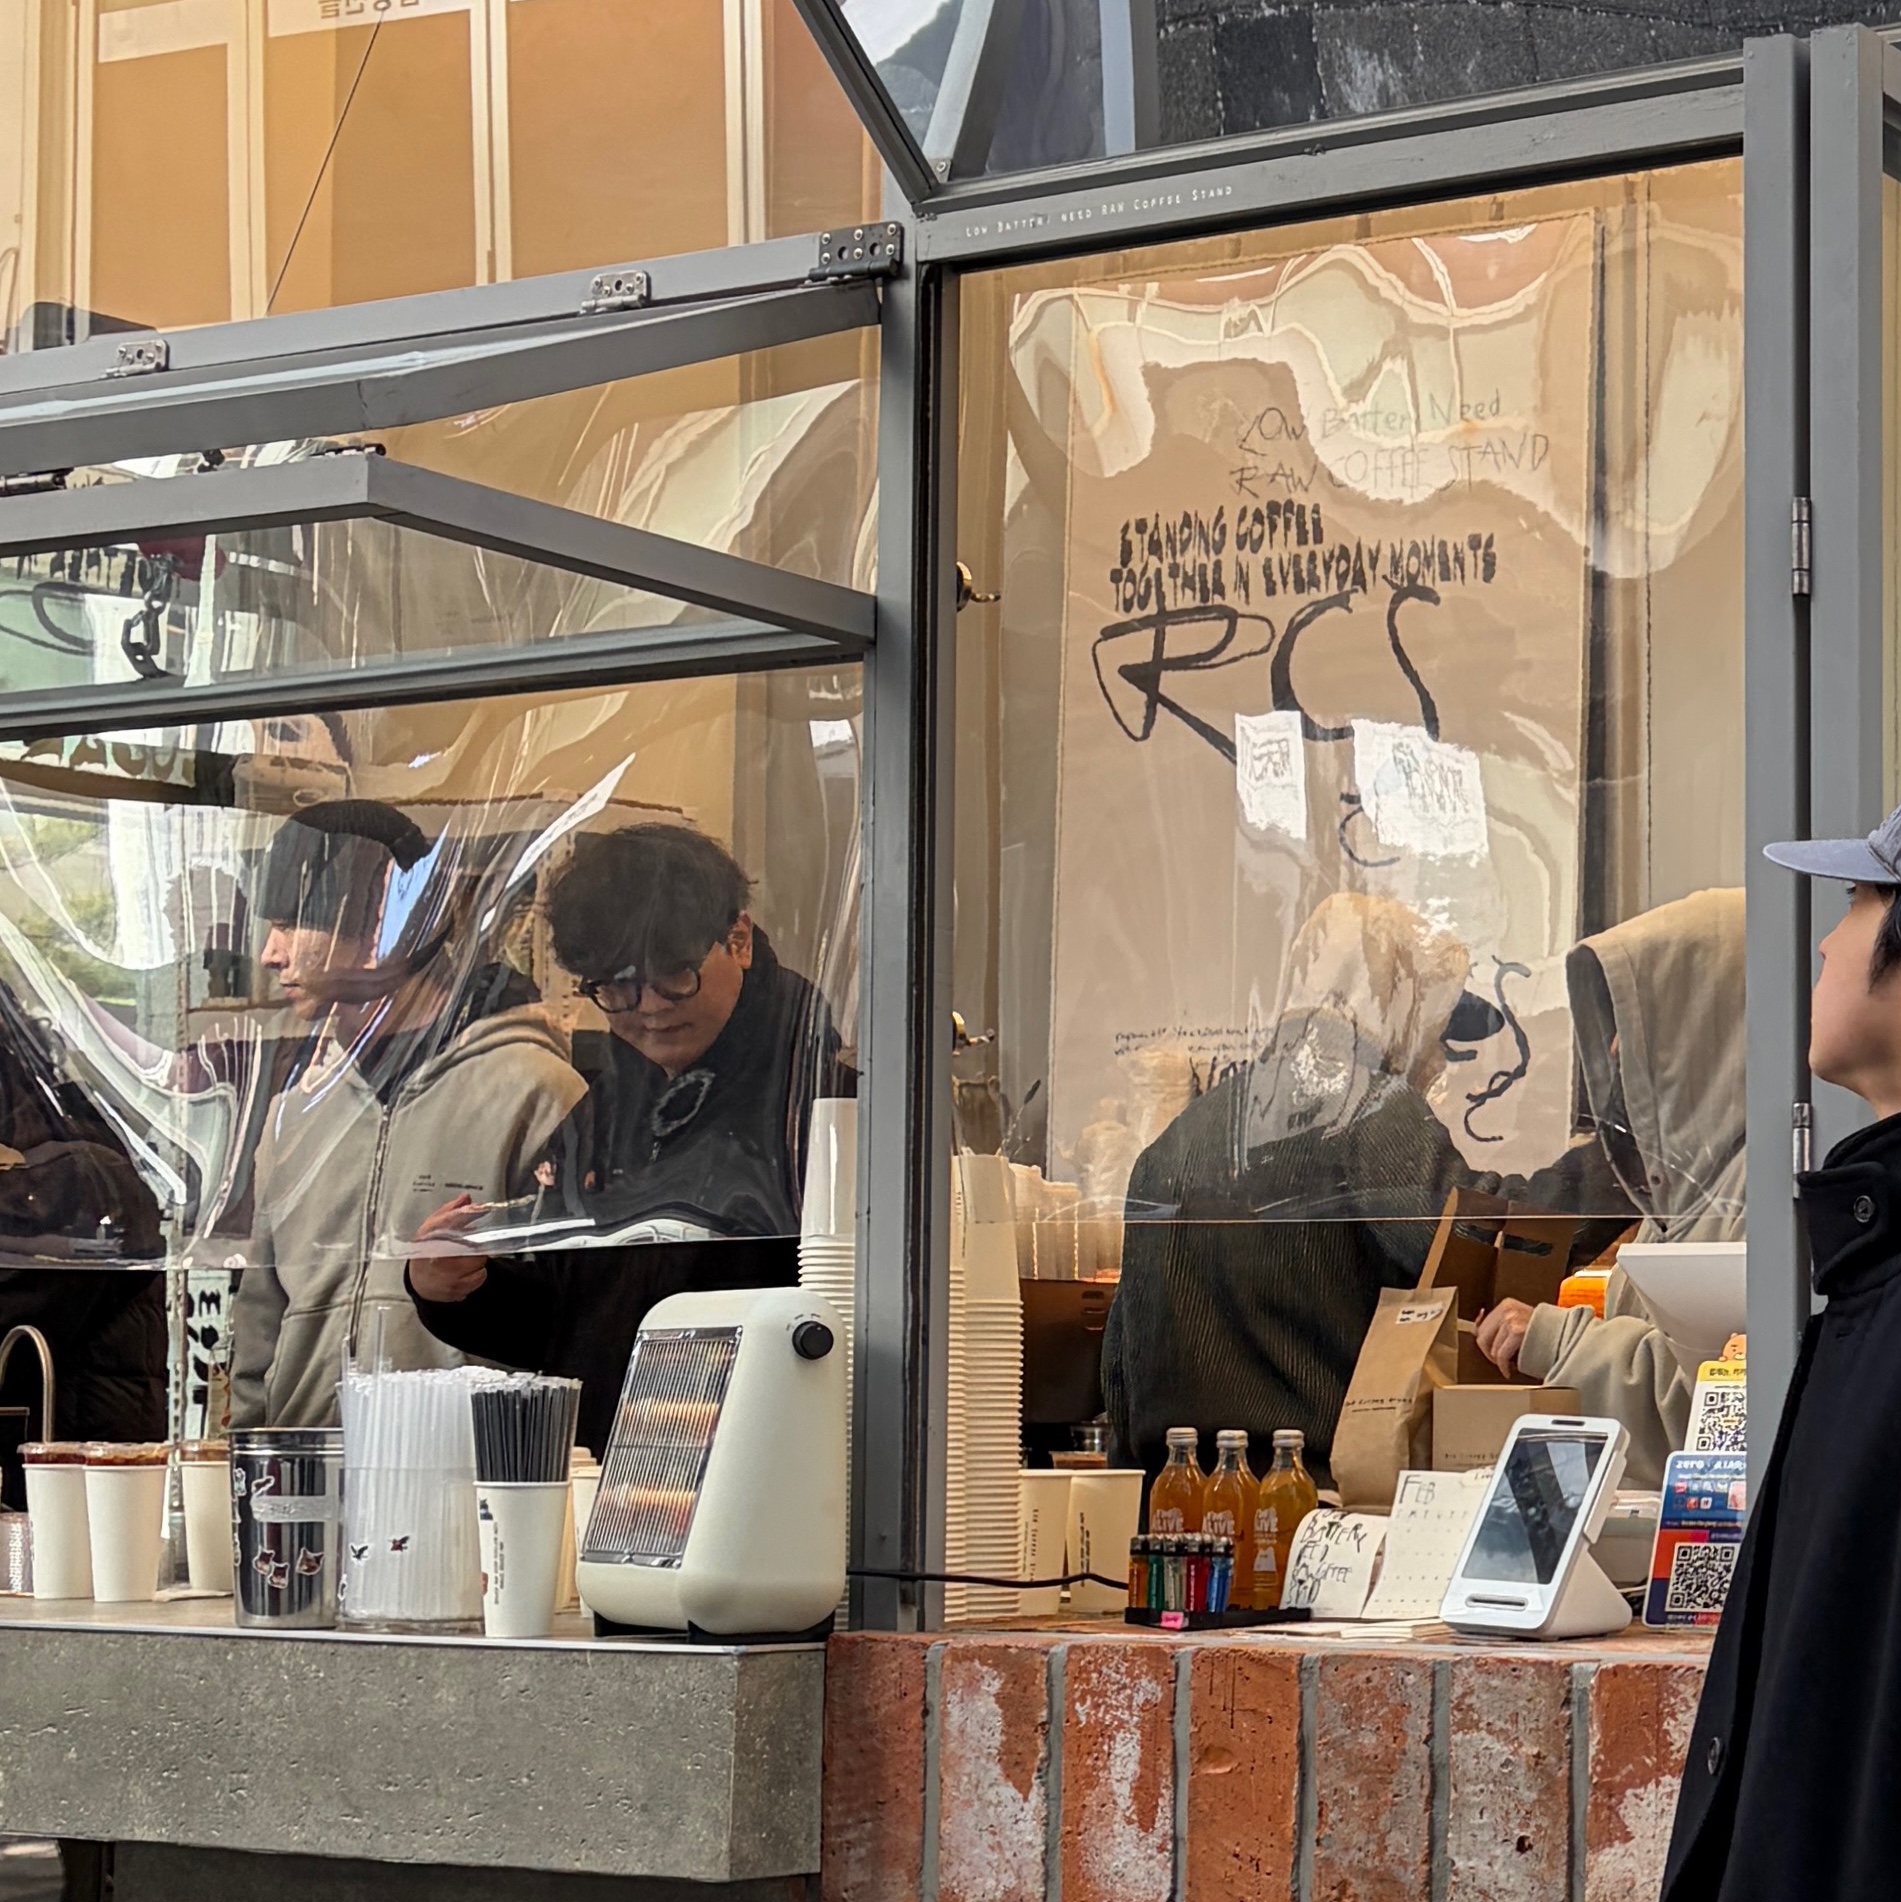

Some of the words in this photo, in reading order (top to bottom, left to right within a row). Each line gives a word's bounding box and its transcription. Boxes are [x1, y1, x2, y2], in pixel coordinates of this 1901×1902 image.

[1229, 455, 1317, 499] RAW
[1438, 432, 1550, 494] STAND
[1119, 505, 1228, 568] STANDING
[1235, 499, 1324, 554] COFFEE
[1389, 531, 1498, 587] MOMENTS
